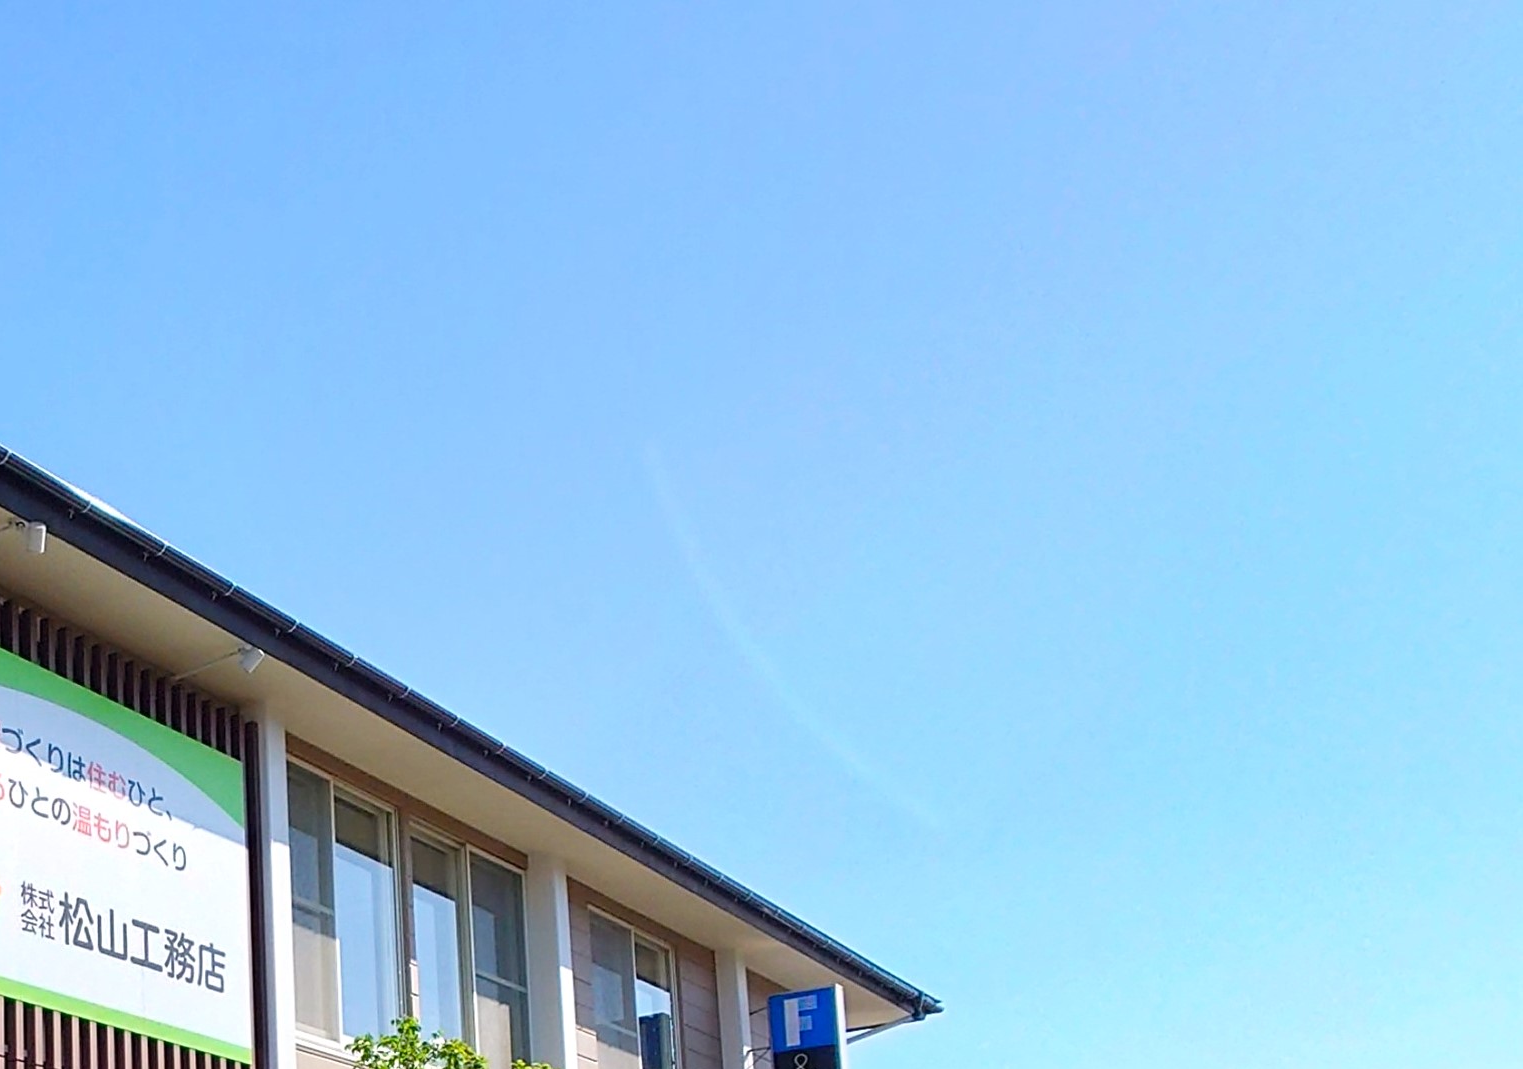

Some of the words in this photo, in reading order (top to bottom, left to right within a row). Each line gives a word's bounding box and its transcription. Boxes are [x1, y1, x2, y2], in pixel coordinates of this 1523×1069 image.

[21, 880, 55, 914] 株式
[20, 908, 56, 941] 会社
[59, 891, 226, 993] 松山工務店
[783, 994, 818, 1047] F
